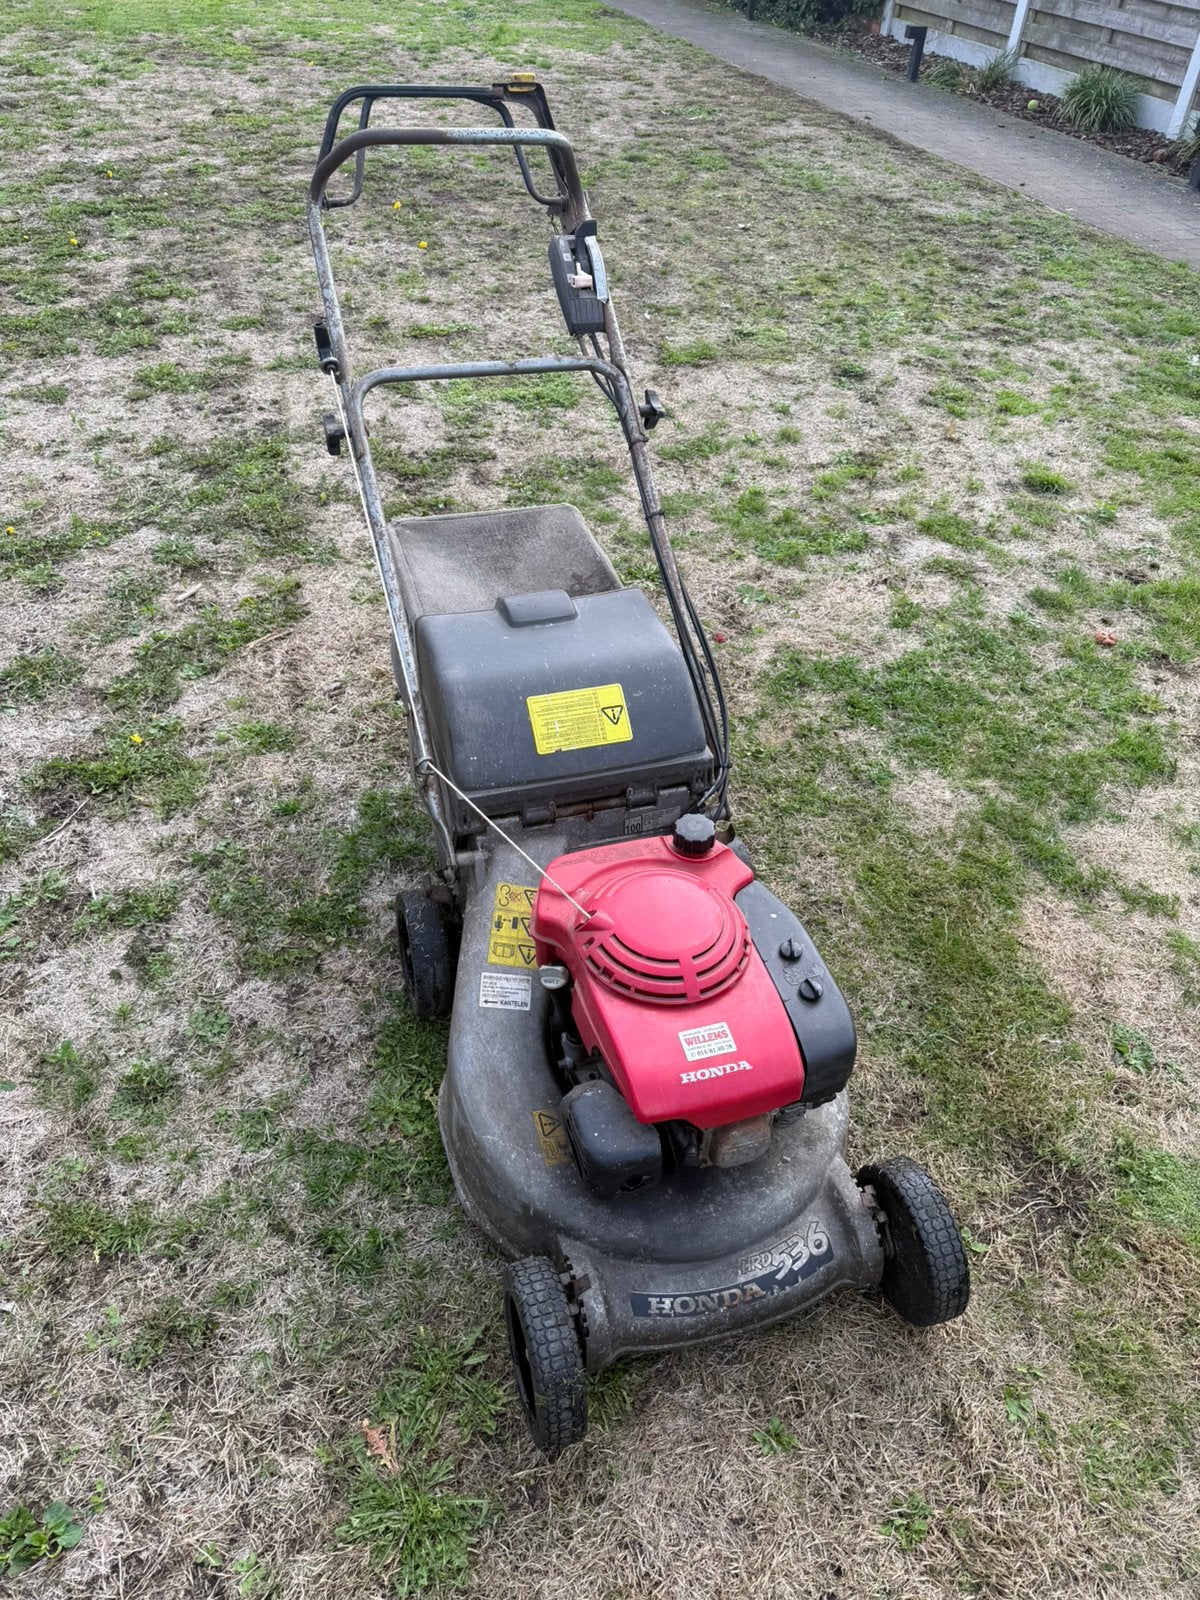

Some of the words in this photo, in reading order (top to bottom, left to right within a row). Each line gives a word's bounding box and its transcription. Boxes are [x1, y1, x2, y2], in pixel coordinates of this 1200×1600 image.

[625, 822, 641, 832] 100
[500, 1000, 528, 1008] KANTELEN
[684, 1030, 729, 1046] WILLEMS
[681, 1060, 753, 1083] HONDA
[771, 1221, 829, 1280] 536
[648, 1282, 766, 1314] HONDA
